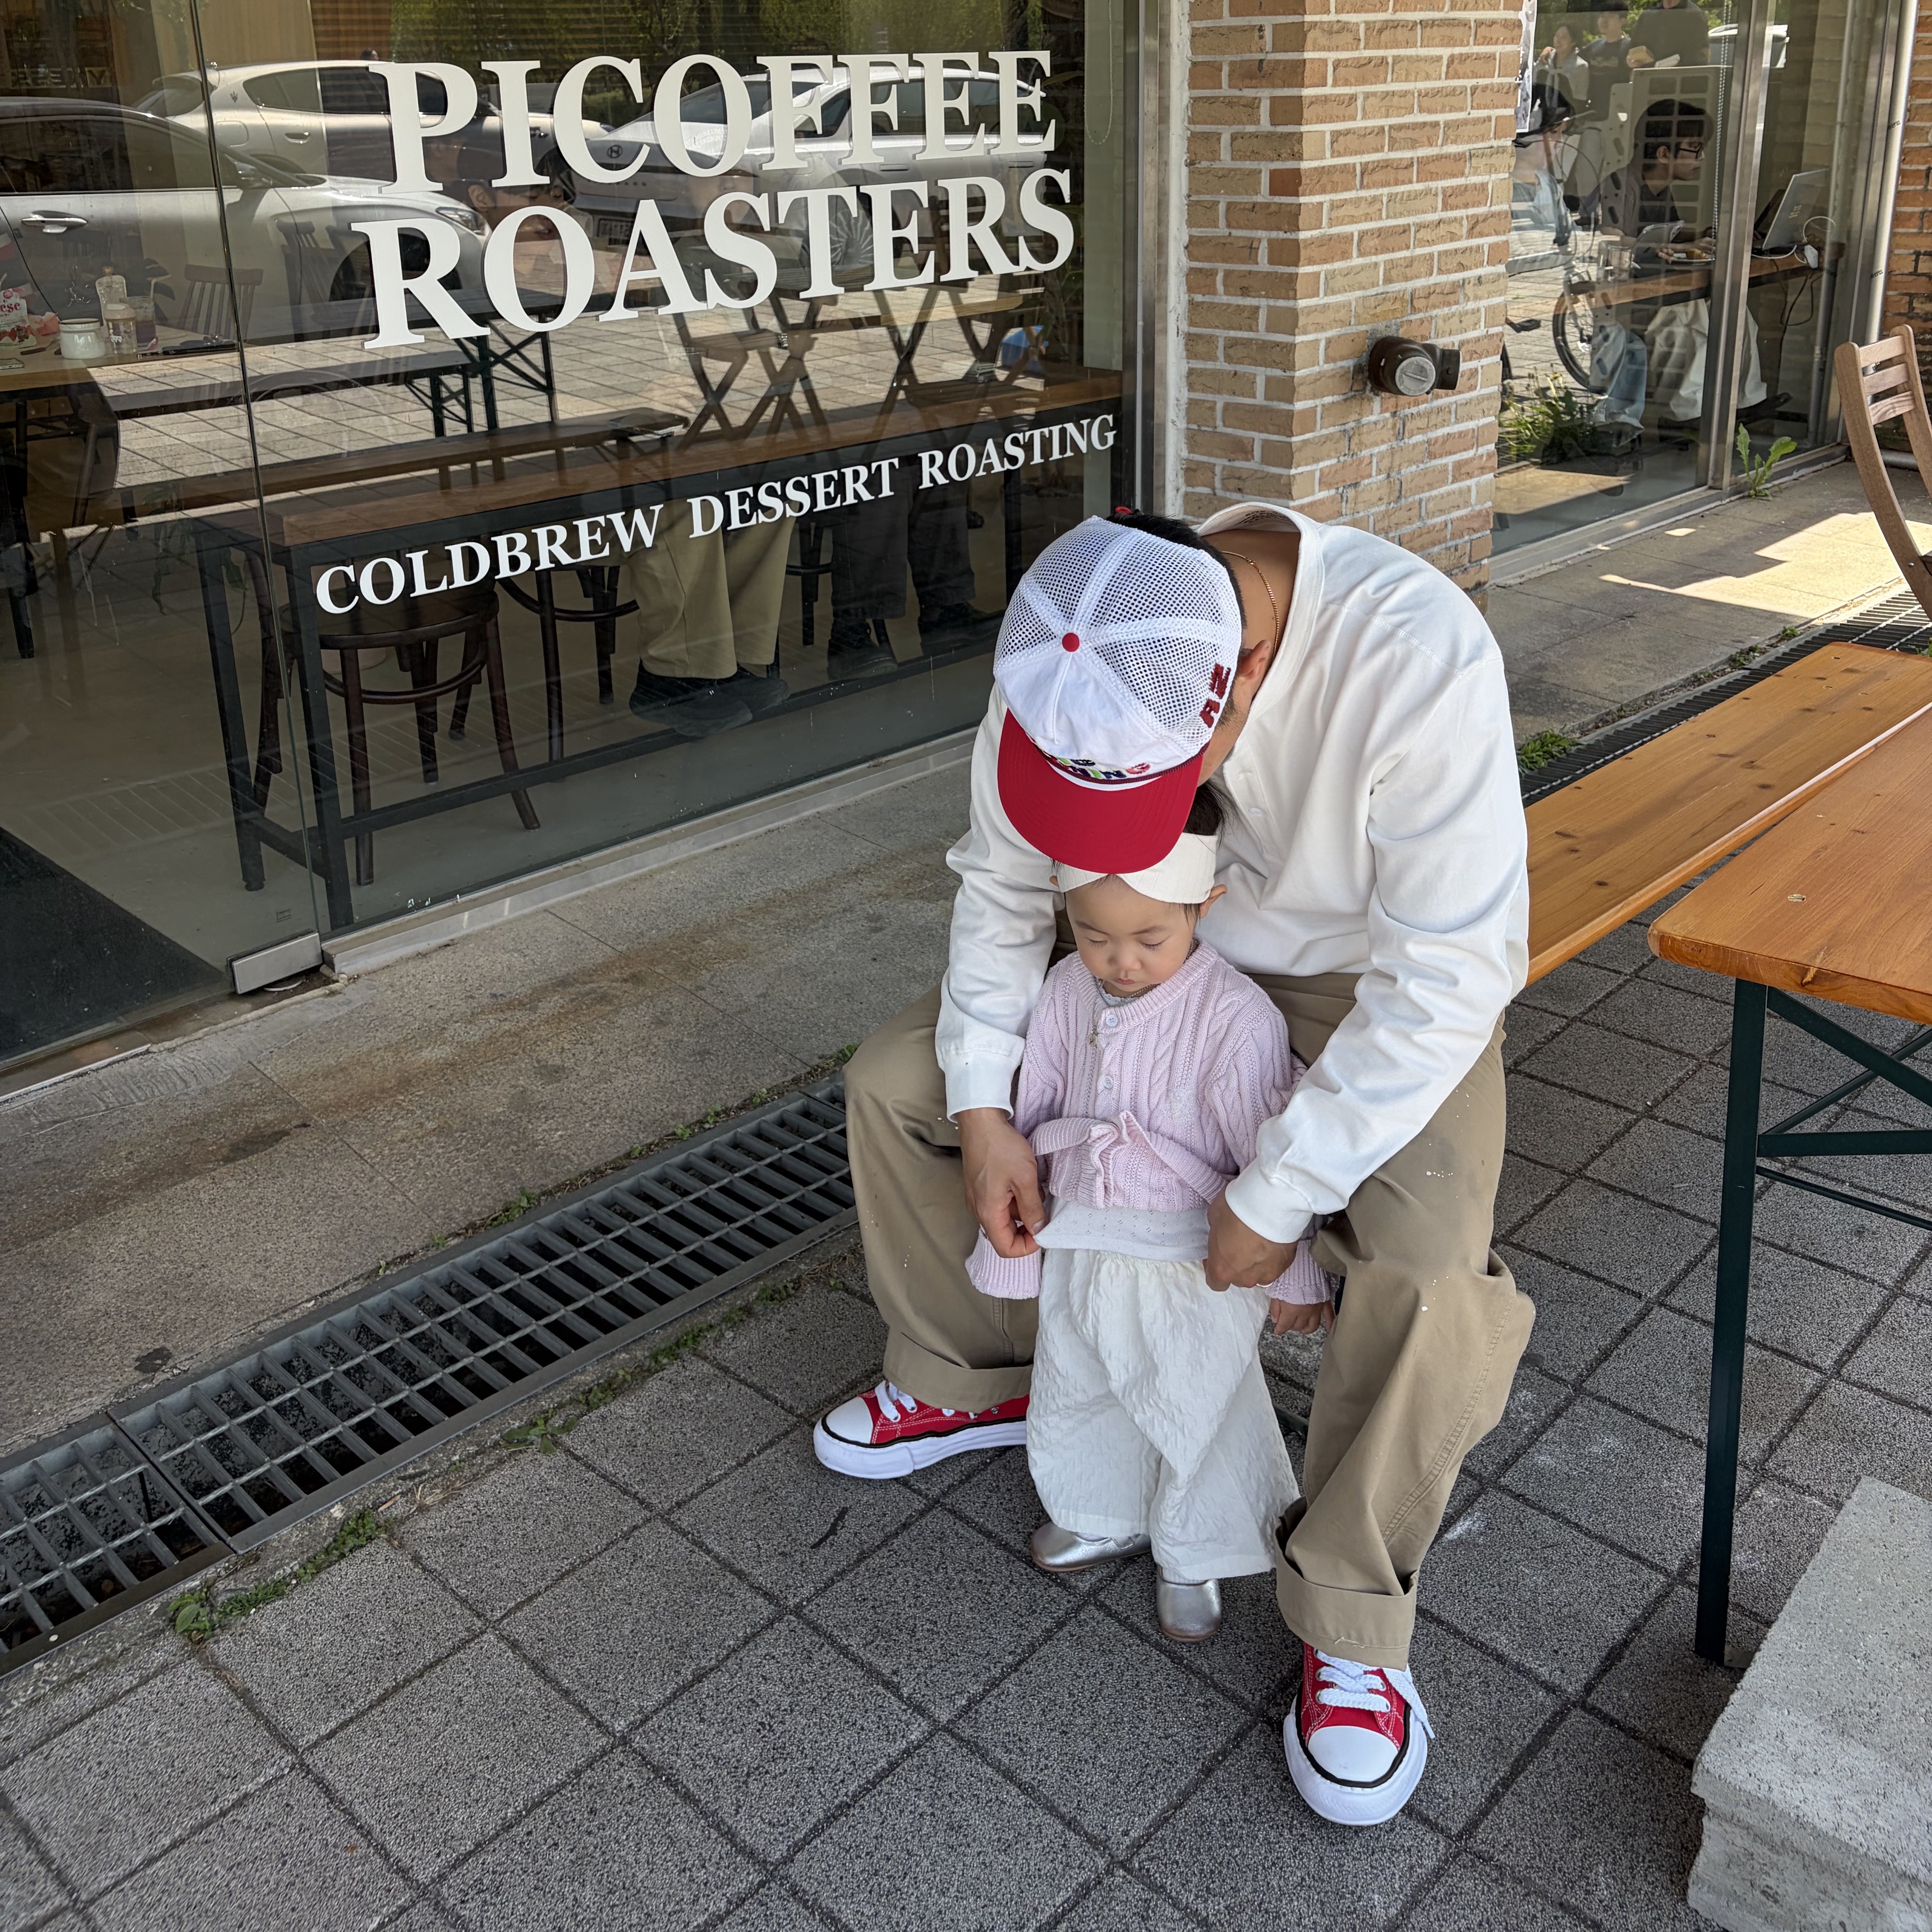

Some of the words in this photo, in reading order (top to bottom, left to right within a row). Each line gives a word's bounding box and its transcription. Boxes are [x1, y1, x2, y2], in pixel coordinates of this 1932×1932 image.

[368, 50, 1056, 194] PICOFFEE
[351, 169, 1074, 349] ROASTERS
[317, 505, 663, 614] COLDBREW
[687, 458, 899, 538] DESSERT
[918, 414, 1116, 489] ROASTING
